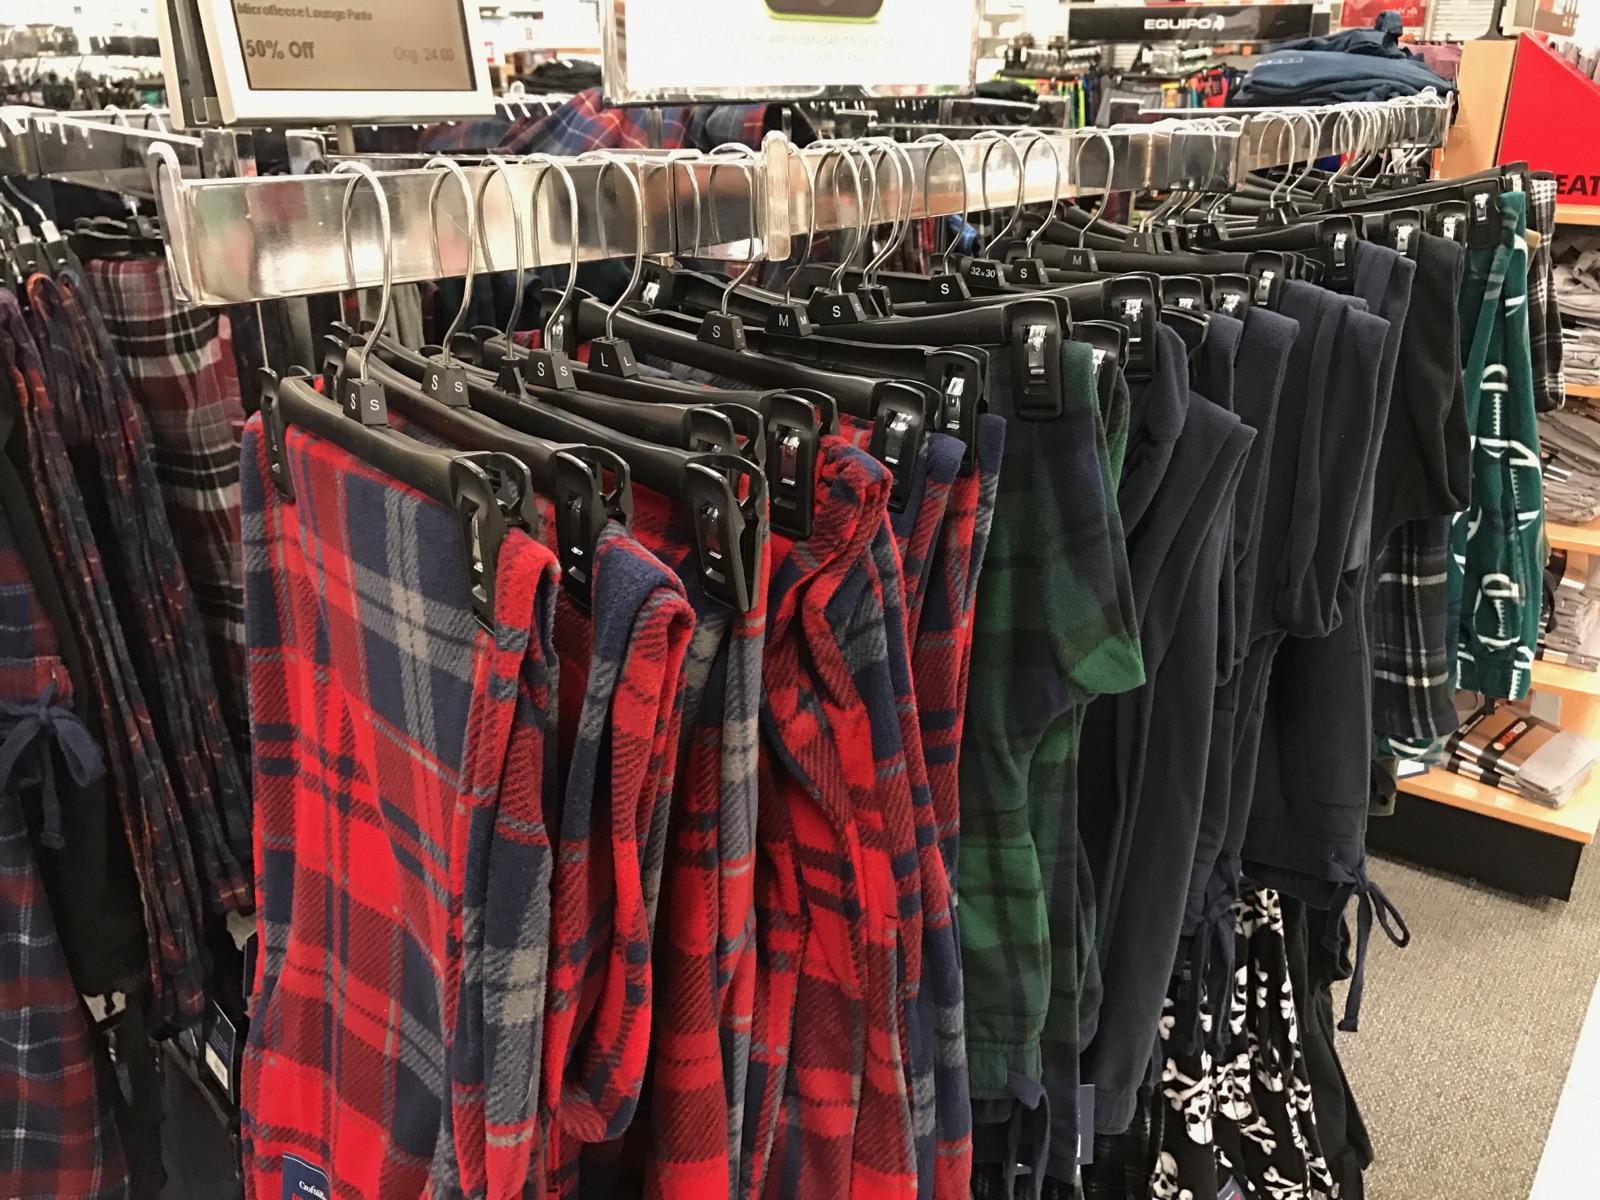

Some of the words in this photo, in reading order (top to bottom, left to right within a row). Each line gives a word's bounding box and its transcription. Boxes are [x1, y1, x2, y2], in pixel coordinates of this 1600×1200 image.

[1144, 18, 1212, 30] EQUIPO
[246, 39, 285, 59] 50%
[289, 41, 315, 59] Off
[1554, 174, 1600, 197] EAT
[1349, 188, 1357, 196] M
[1266, 212, 1274, 222] M
[1133, 237, 1140, 248] L
[1072, 255, 1082, 265] M
[1020, 268, 1028, 279] S
[940, 283, 950, 295] S
[832, 305, 841, 318] S
[778, 313, 789, 327] M
[712, 325, 721, 338] S
[736, 328, 742, 338] S
[600, 352, 609, 367] L
[623, 356, 632, 367] L
[537, 361, 545, 377] S
[560, 366, 569, 377] S
[431, 374, 439, 390] S
[454, 381, 464, 393] S
[350, 393, 356, 410] S
[369, 399, 380, 411] S
